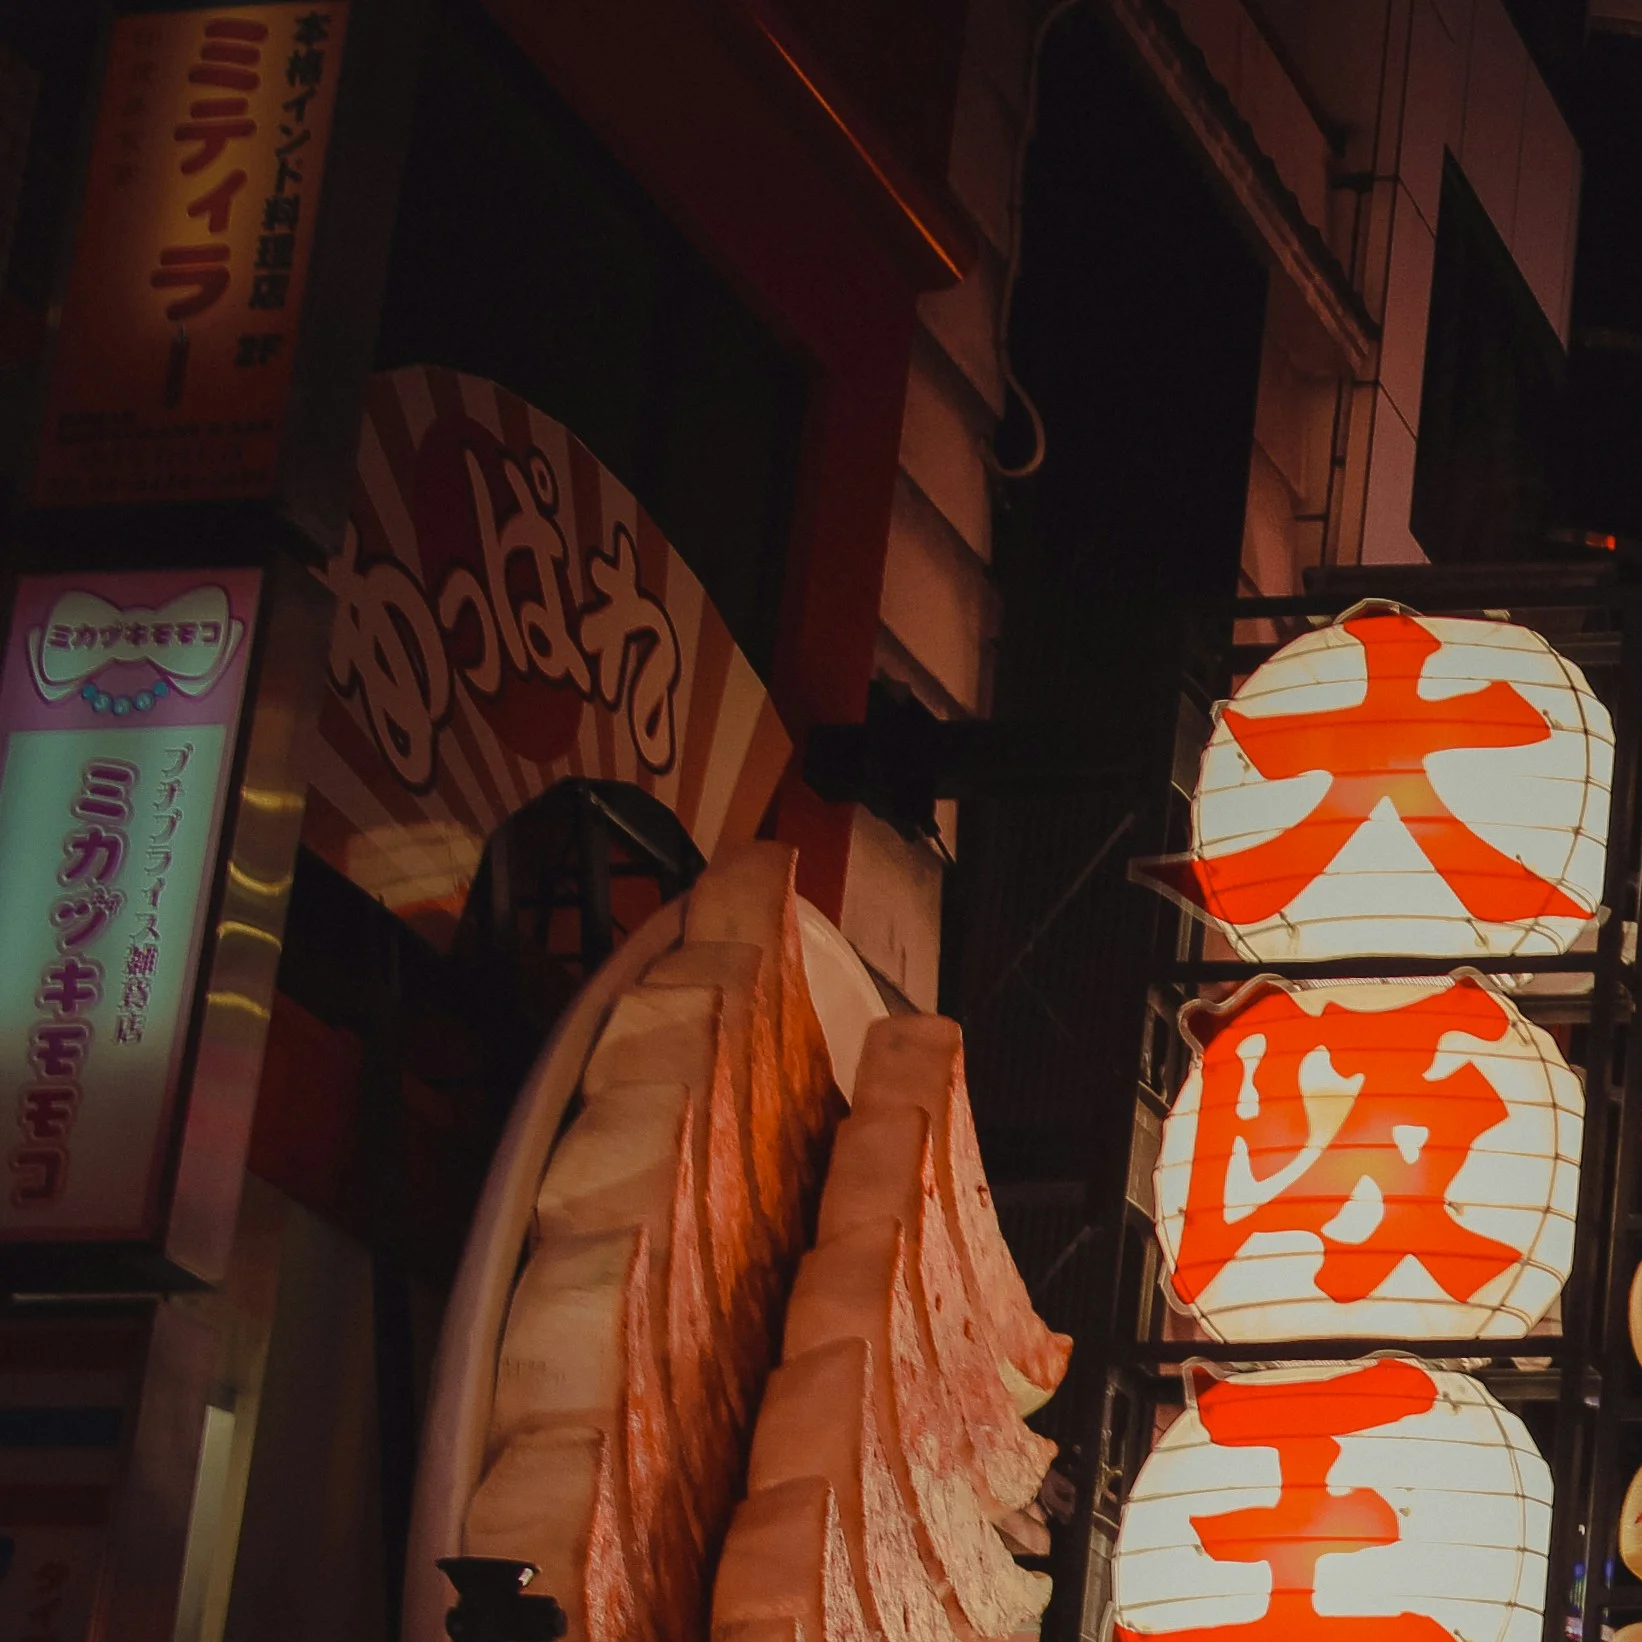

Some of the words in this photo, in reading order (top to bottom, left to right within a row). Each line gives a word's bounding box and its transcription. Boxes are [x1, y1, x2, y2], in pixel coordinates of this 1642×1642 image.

[151, 17, 269, 408] ミティラー
[305, 448, 684, 792] あっぱれ
[9, 759, 136, 1202] ミカヅキモモコ
